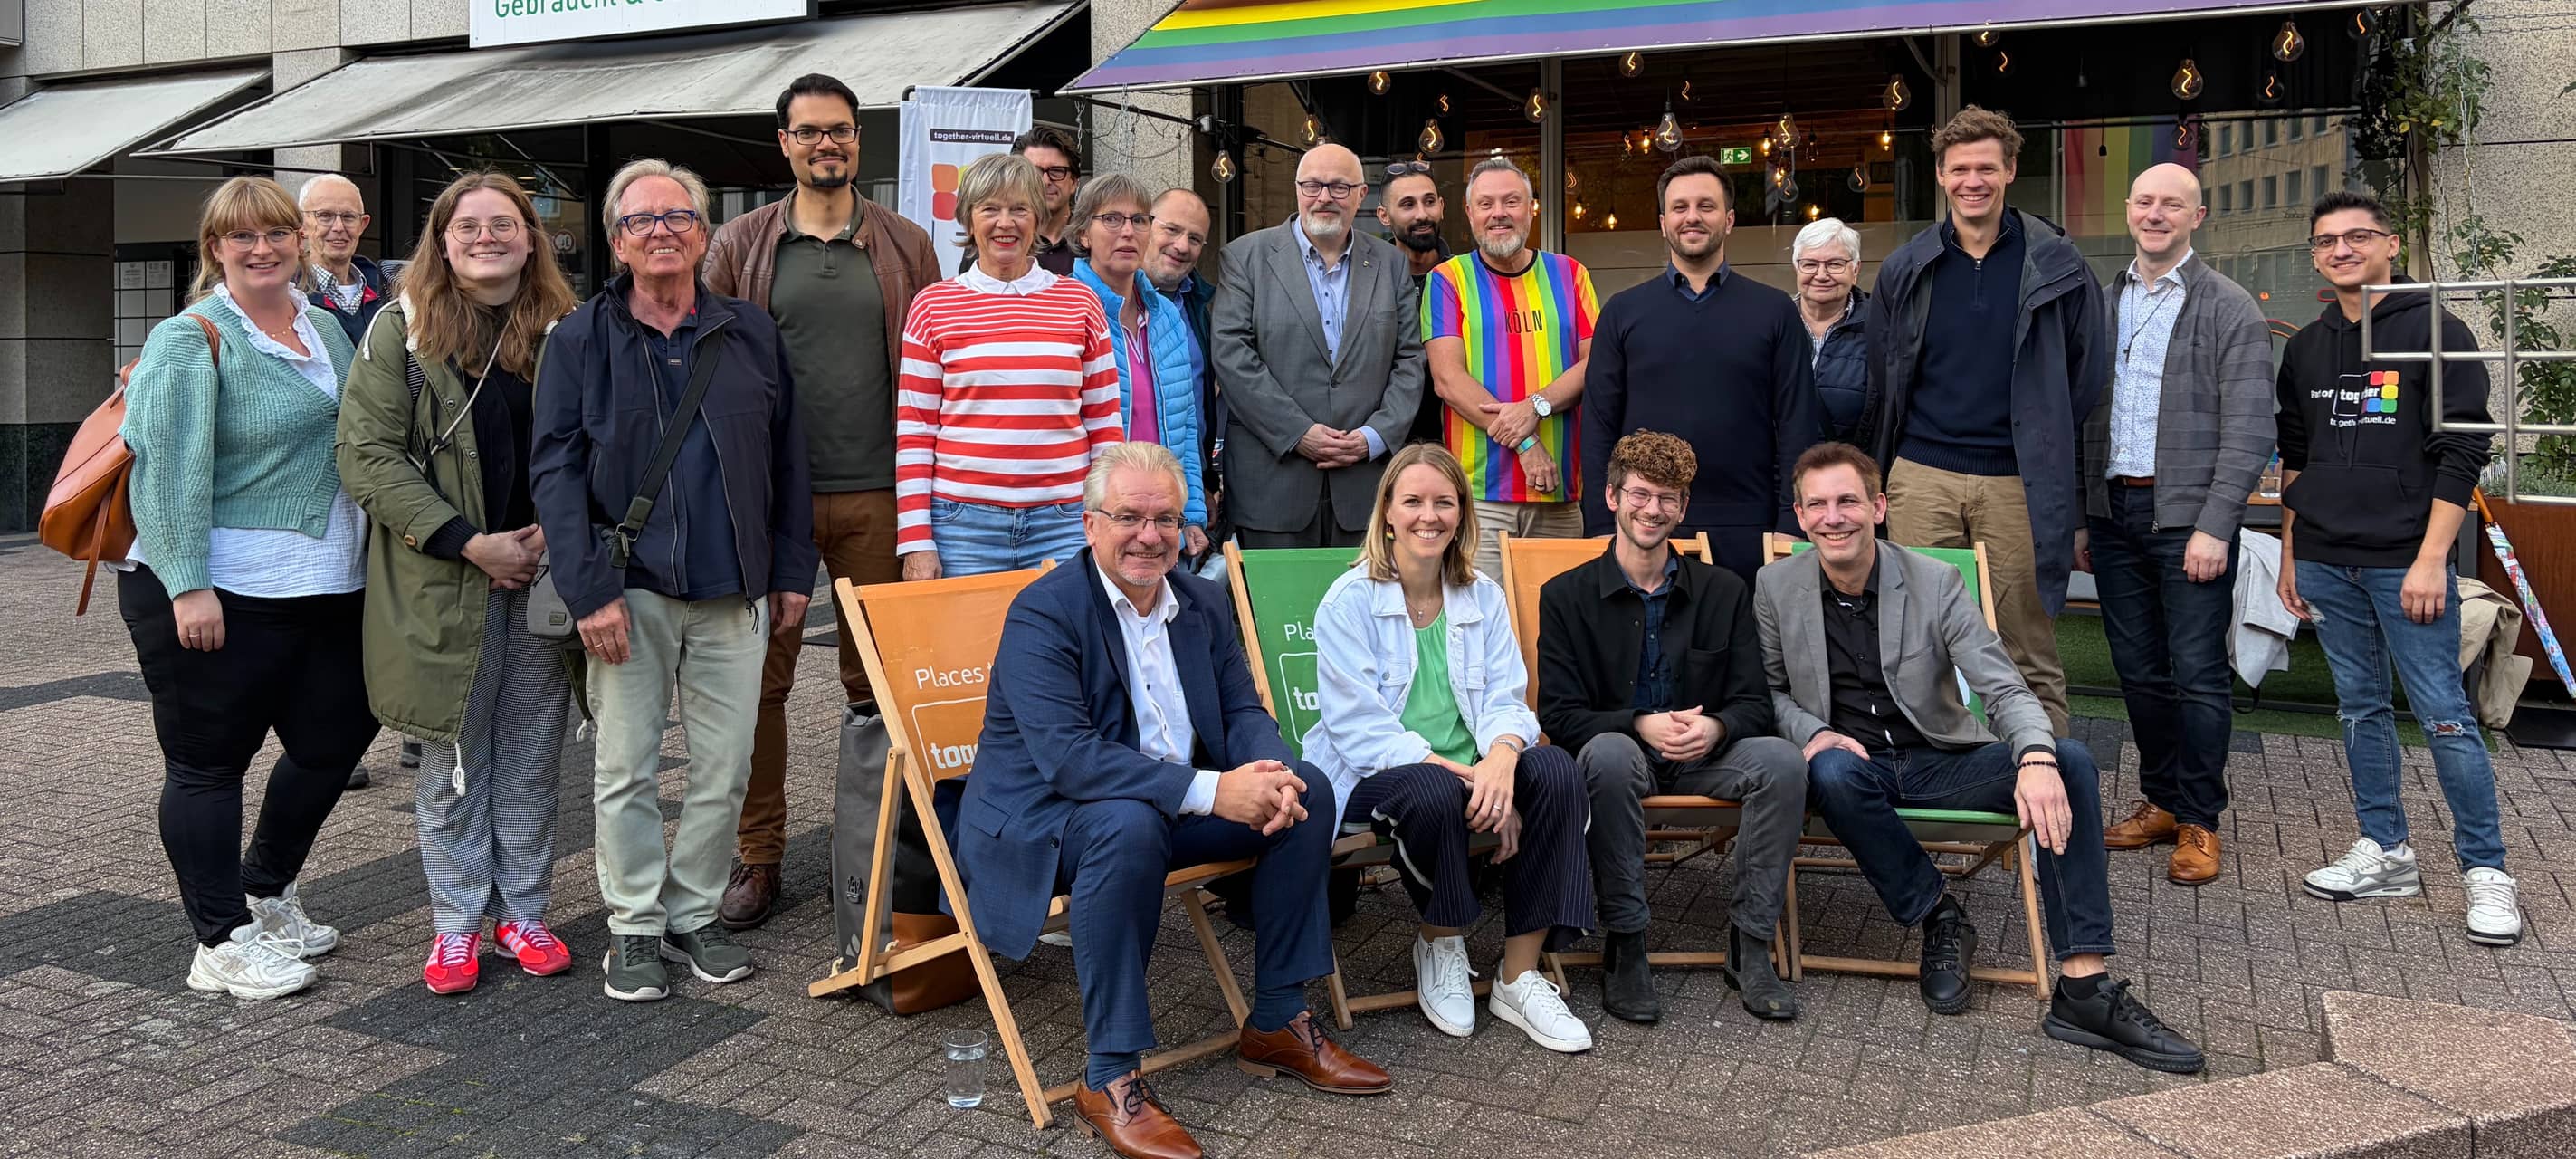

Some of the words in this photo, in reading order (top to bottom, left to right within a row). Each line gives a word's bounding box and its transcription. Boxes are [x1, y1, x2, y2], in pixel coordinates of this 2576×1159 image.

[495, 0, 616, 17] Gebrauc
[934, 131, 1012, 141] together-virtuell.de
[1504, 308, 1543, 334] KÖLN
[1283, 621, 1315, 641] Pla
[915, 666, 985, 689] Places
